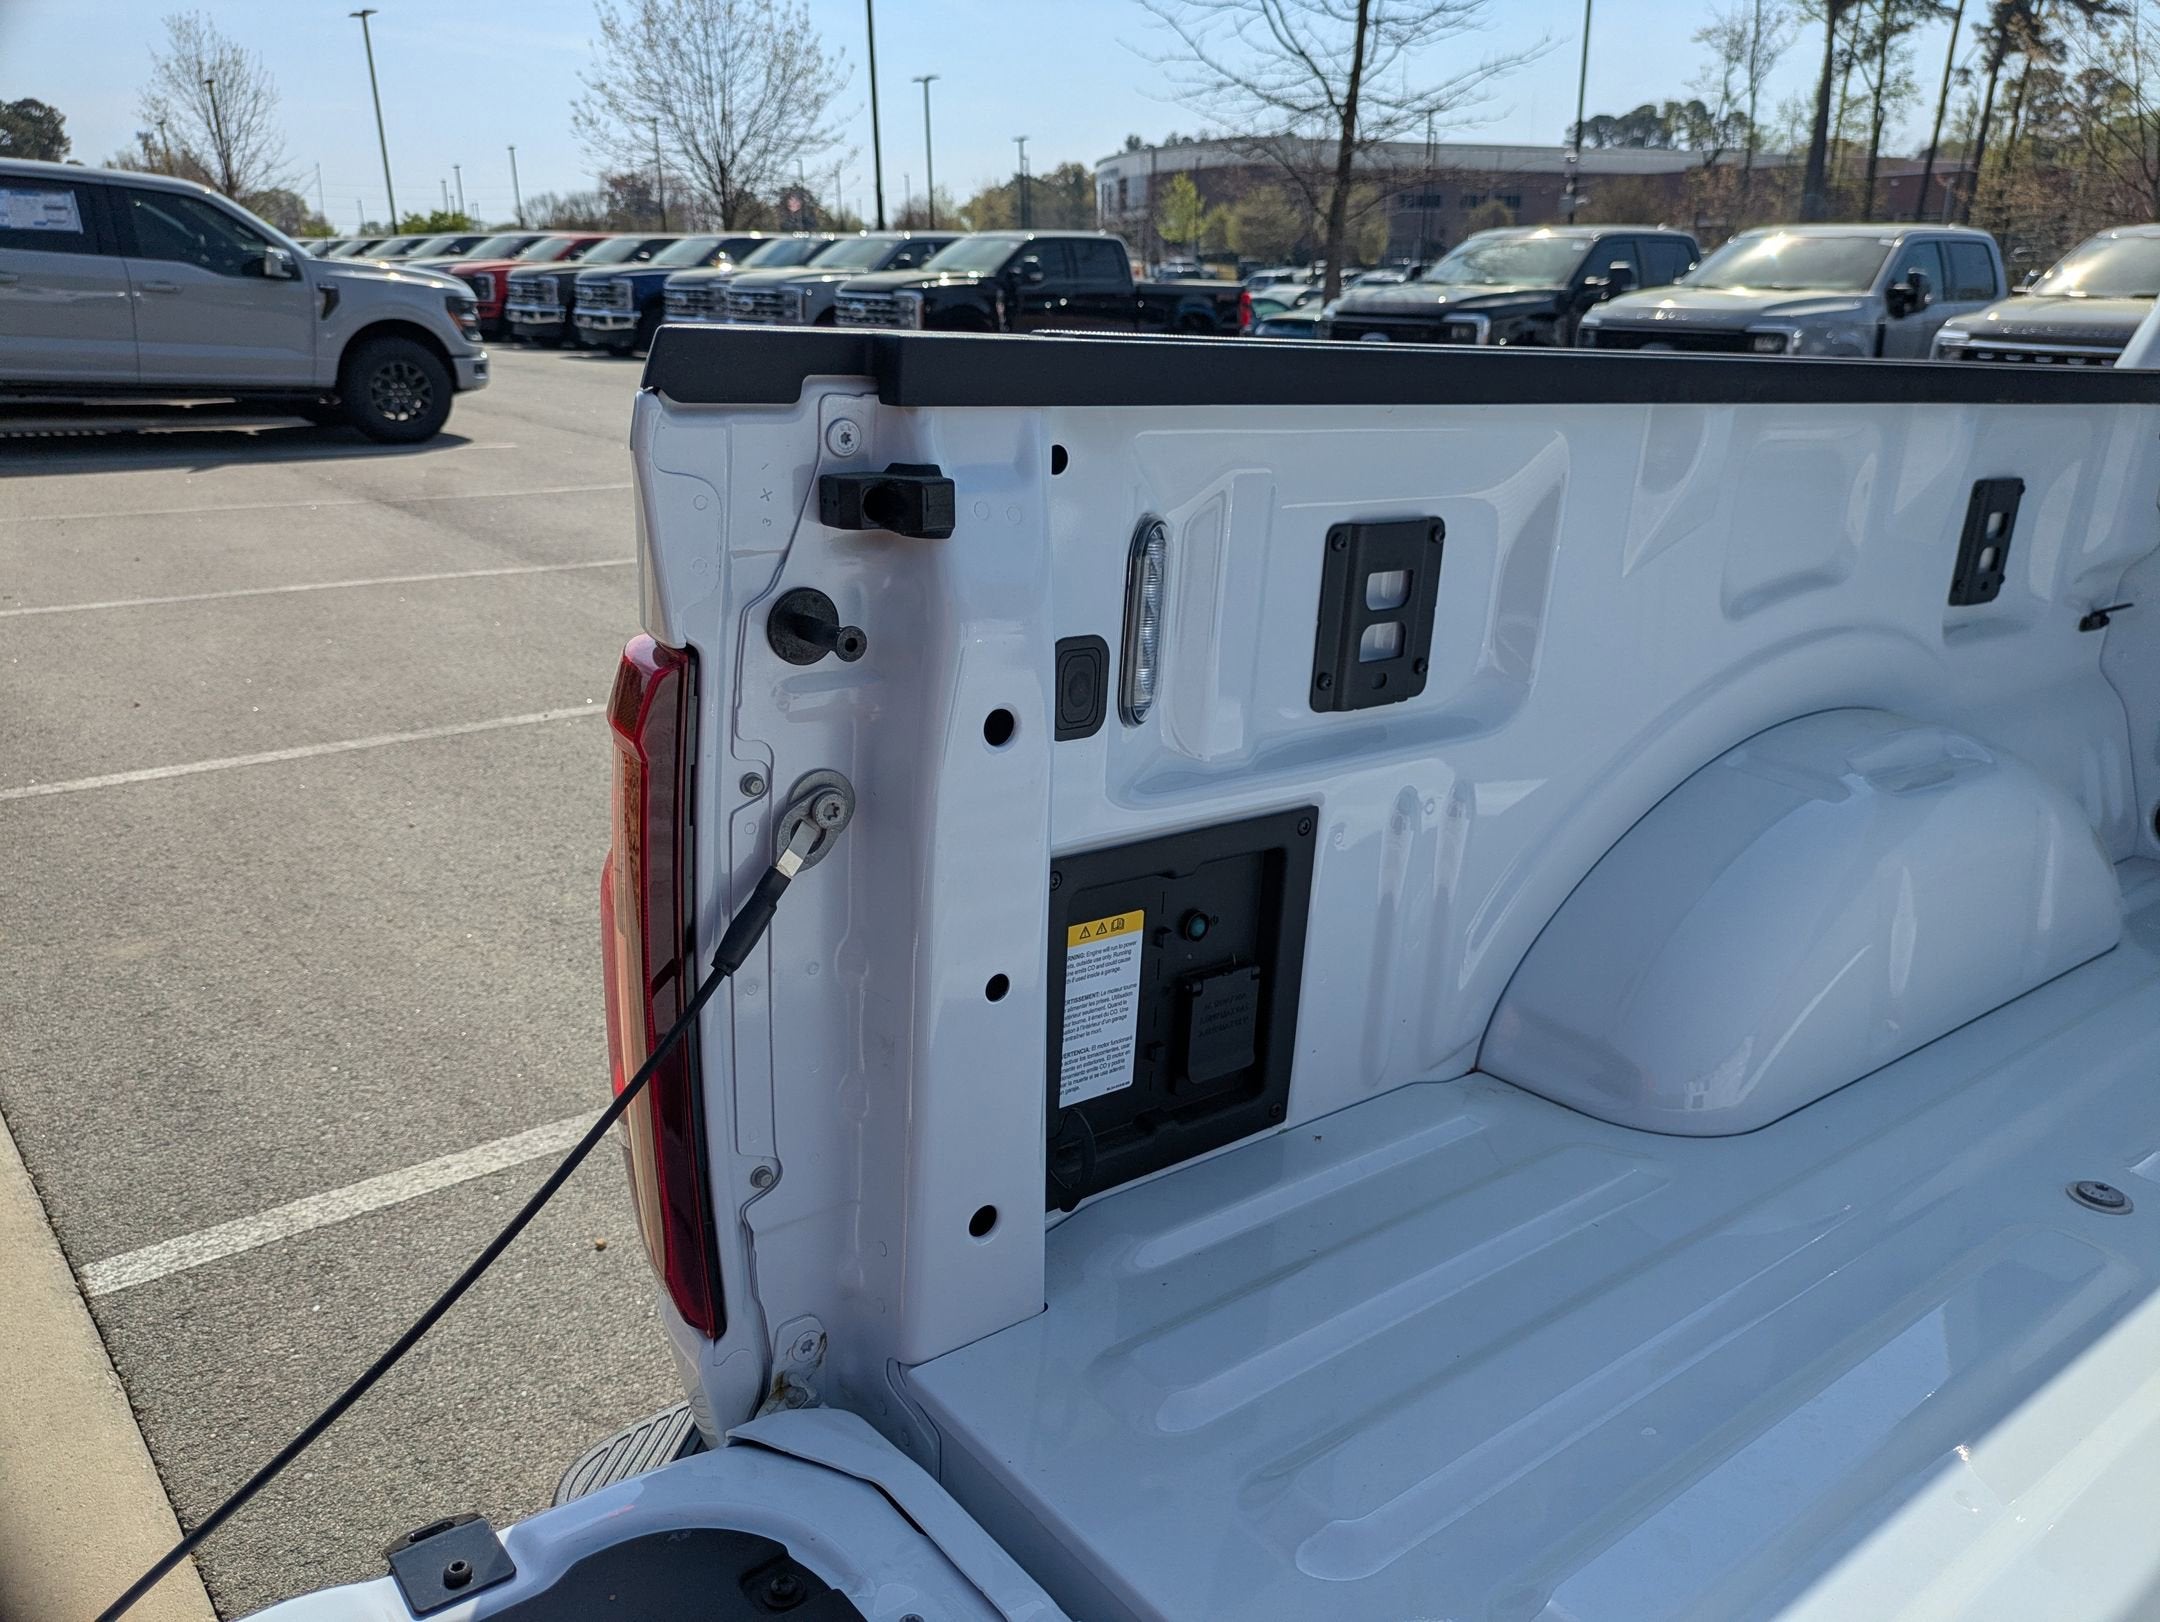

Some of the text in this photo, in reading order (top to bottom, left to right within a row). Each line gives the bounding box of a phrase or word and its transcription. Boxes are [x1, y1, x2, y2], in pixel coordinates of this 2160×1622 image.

[1087, 949, 1102, 957] Engine
[1076, 959, 1093, 967] outside
[1113, 949, 1132, 958] Running
[1087, 971, 1100, 979] inside
[1107, 1001, 1122, 1009] Quand
[1112, 1015, 1127, 1023] garage
[1097, 1042, 1110, 1050] motor
